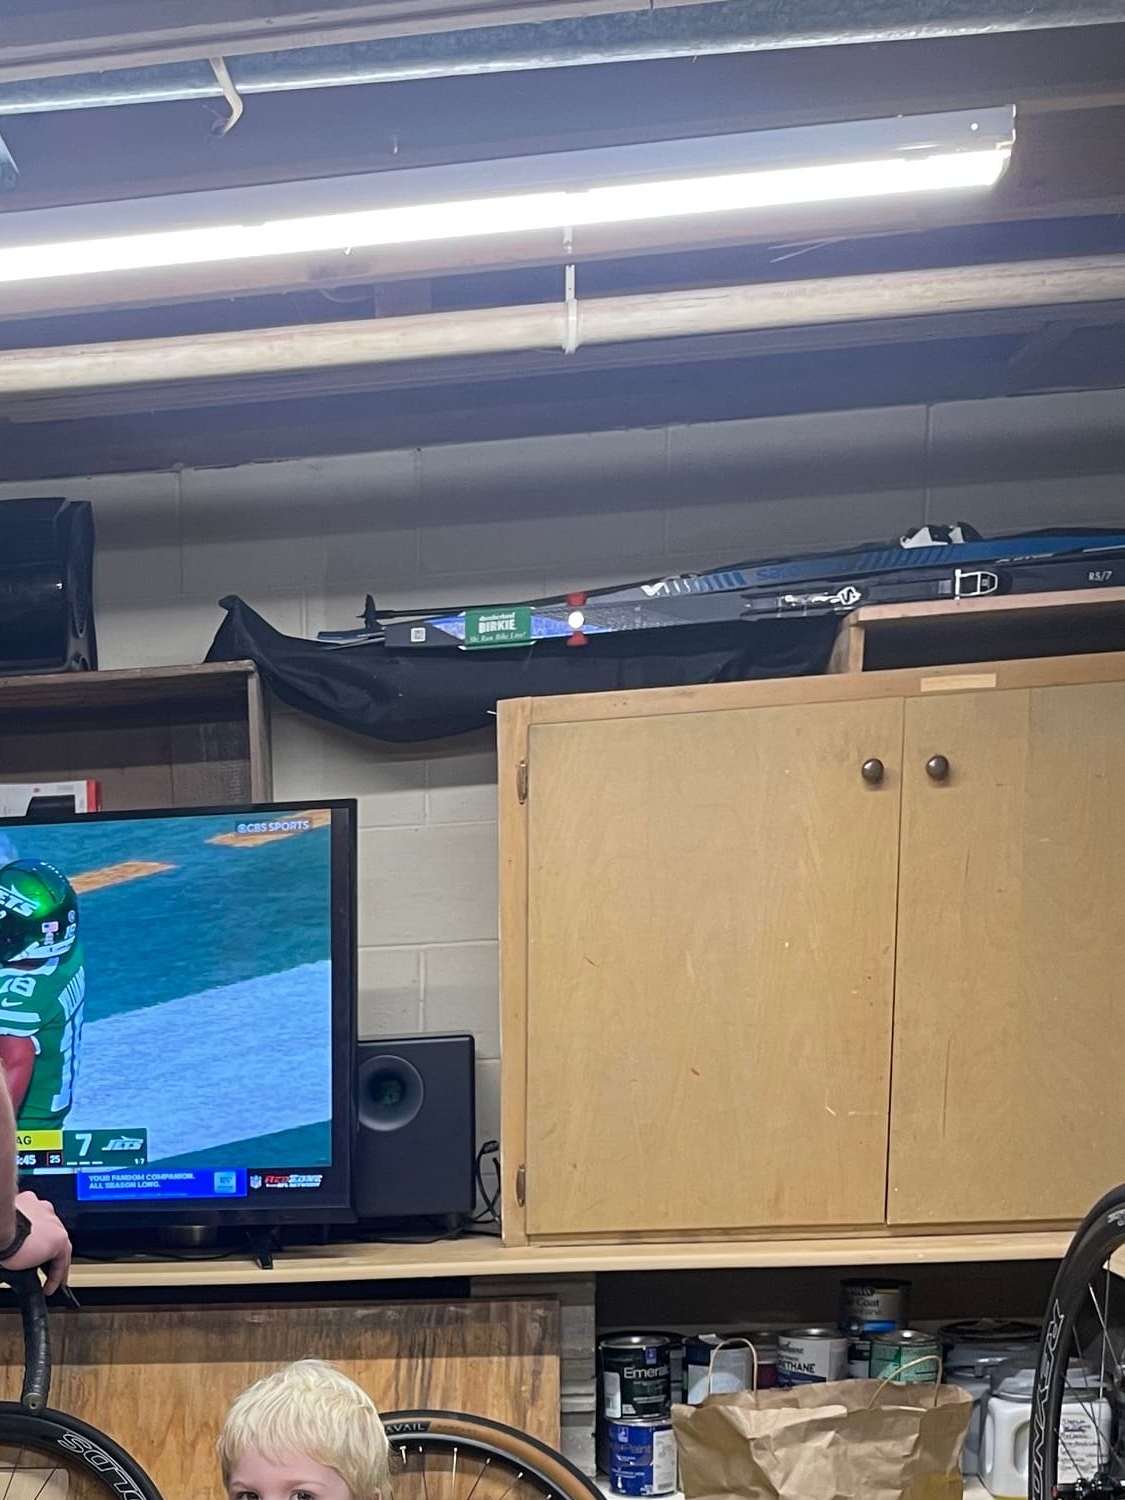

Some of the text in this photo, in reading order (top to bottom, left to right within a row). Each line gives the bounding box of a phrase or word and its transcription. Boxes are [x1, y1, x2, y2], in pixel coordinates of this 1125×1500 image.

[478, 620, 517, 634] BIRKIE
[246, 820, 309, 833] CBS SPORTS
[16, 1135, 32, 1146] AG
[75, 1133, 145, 1157] 7 JETS
[49, 1154, 61, 1164] 25
[111, 1174, 144, 1182] FANDOM
[105, 1181, 136, 1189] SEASON
[385, 1422, 426, 1434] AVAIL
